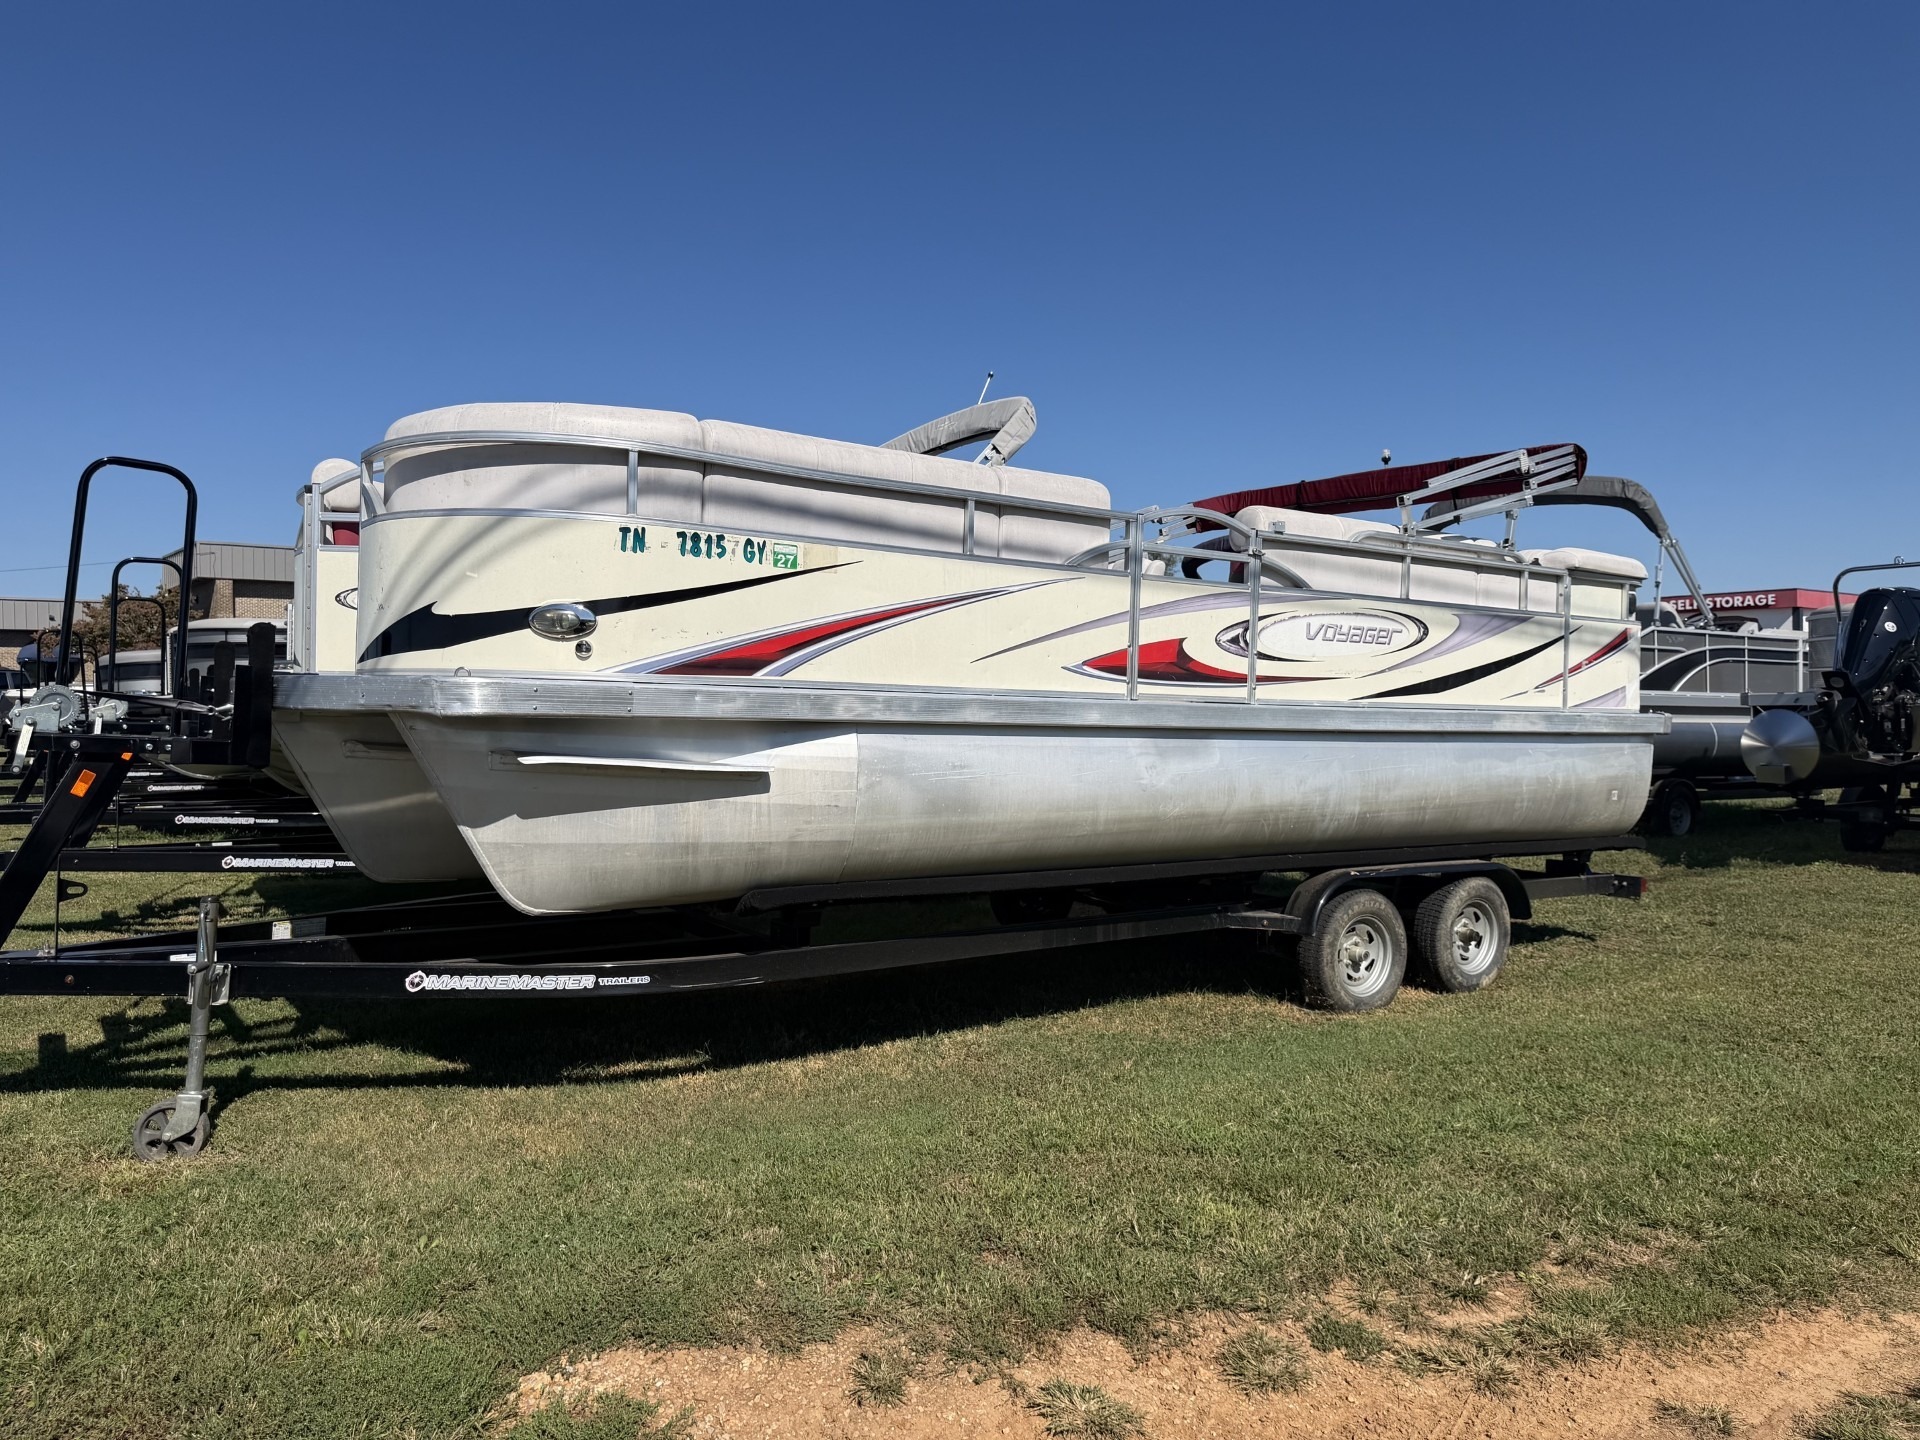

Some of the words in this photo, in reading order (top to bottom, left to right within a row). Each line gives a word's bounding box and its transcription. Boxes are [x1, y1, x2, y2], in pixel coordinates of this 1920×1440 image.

[619, 526, 646, 554] TN
[676, 531, 727, 559] 7815
[743, 537, 767, 565] GY
[776, 554, 795, 569] 27
[1706, 594, 1776, 609] STORAGE
[425, 974, 597, 990] MARINEMASTER
[598, 976, 651, 986] TRAILERS
